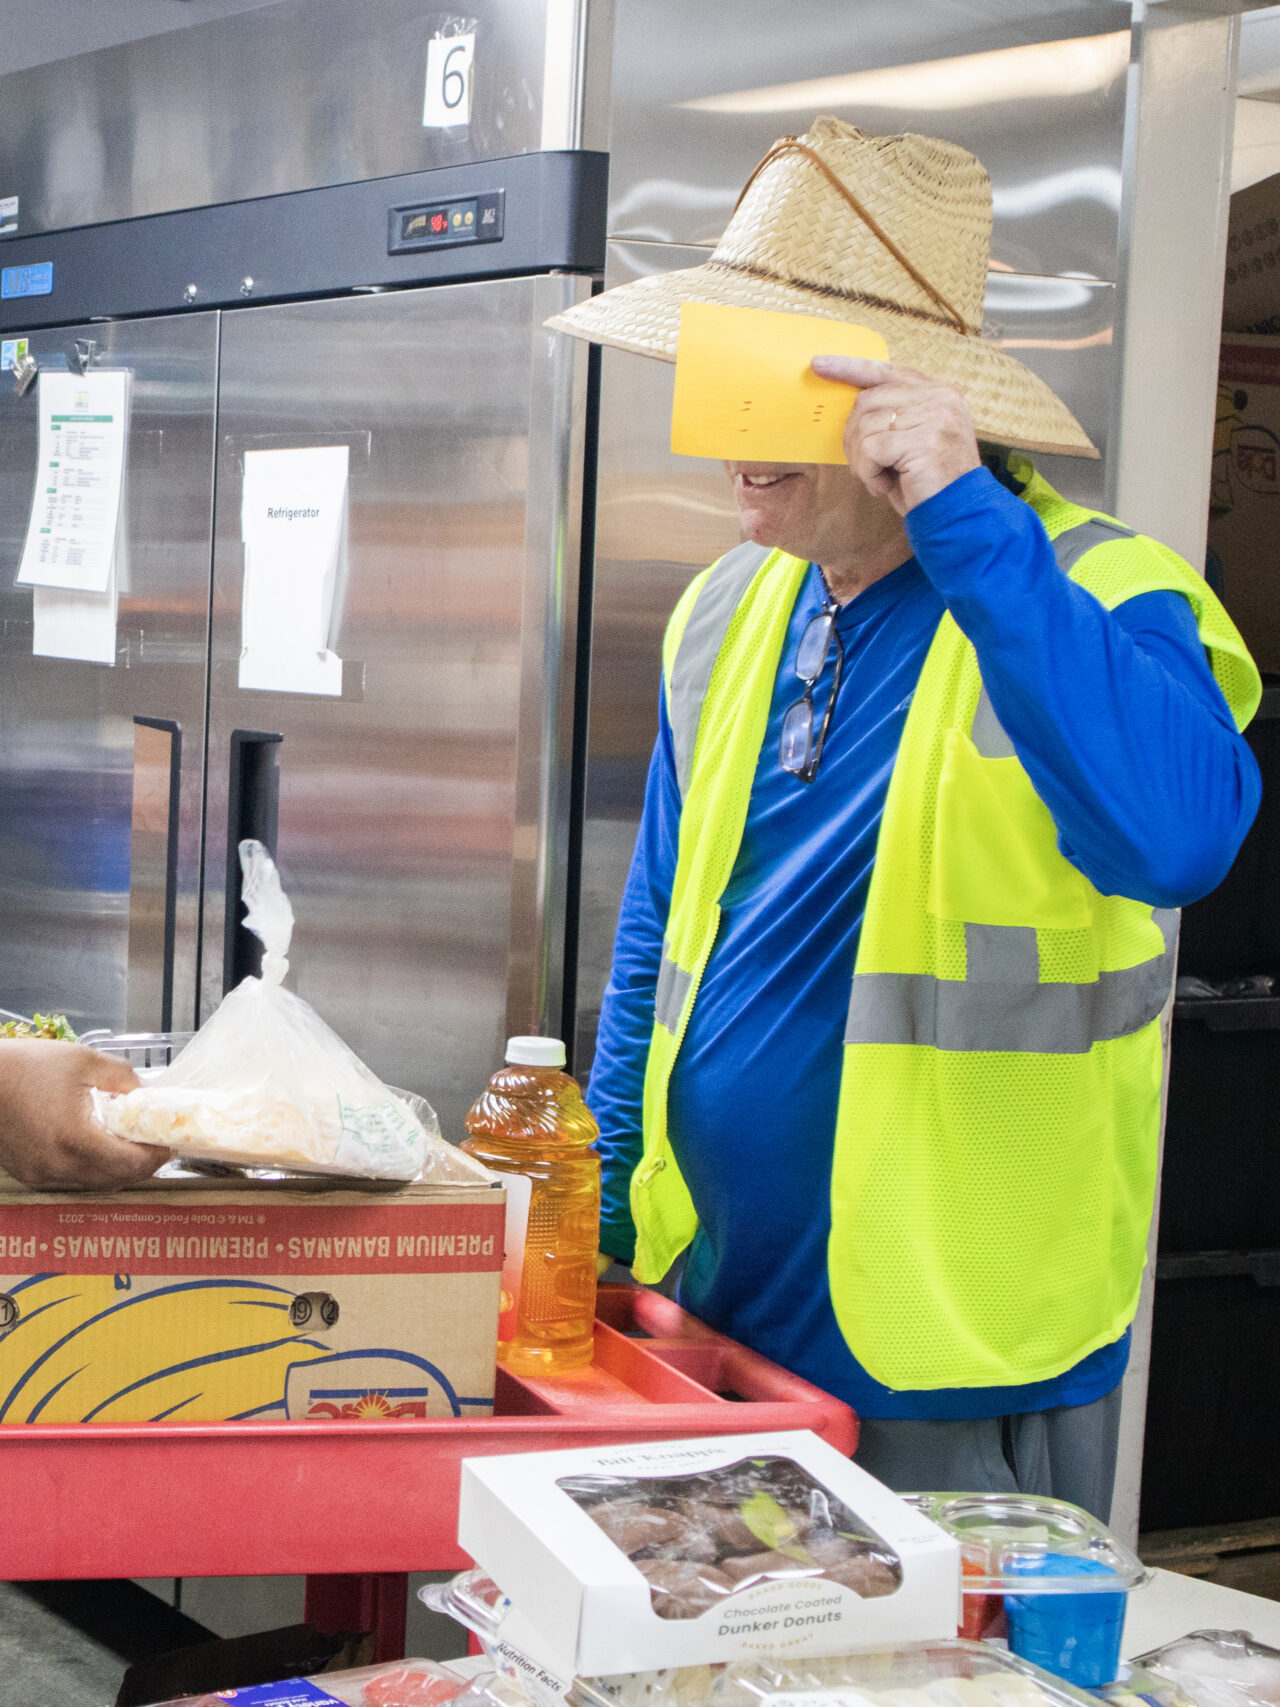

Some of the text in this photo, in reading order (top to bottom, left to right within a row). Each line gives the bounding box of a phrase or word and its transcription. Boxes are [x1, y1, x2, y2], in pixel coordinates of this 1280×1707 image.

[441, 45, 467, 109] 6
[267, 507, 320, 520] Refrigerator
[58, 1213, 85, 1224] 2021
[110, 1213, 161, 1225] Company,
[164, 1213, 189, 1225] Food
[191, 1214, 215, 1225] Dole
[238, 1214, 255, 1225] TM
[53, 1236, 161, 1259] BANANAS
[166, 1236, 269, 1259] PREMIUM
[288, 1235, 391, 1258] BANANAS
[397, 1234, 495, 1256] PREMIUM
[723, 1595, 843, 1619] Chocolate Coated
[718, 1610, 843, 1636] Dunker Donuts
[496, 1642, 562, 1692] Nutrition Facts
